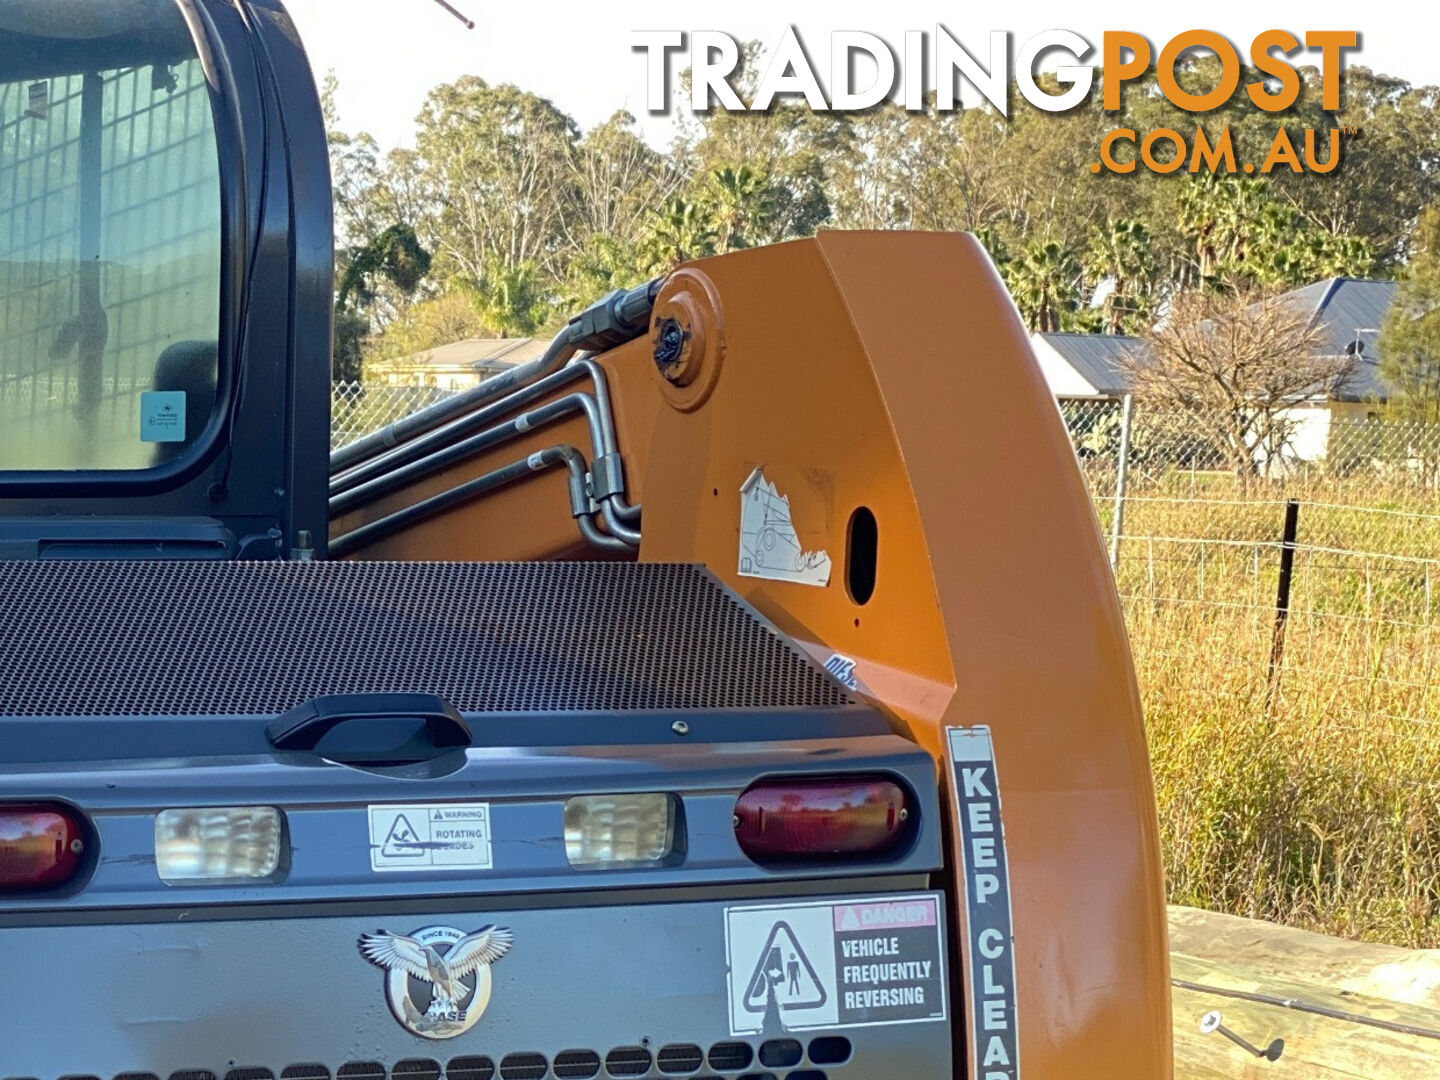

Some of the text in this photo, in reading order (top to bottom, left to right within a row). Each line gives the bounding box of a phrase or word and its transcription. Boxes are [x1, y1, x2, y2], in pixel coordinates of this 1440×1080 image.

[436, 830, 482, 839] ROTATING
[962, 767, 1000, 904] KEEP
[861, 905, 928, 925] DANGER
[842, 937, 900, 957] VEHICLE
[843, 961, 932, 986] FREQUENTLY
[845, 987, 925, 1009] REVERSING
